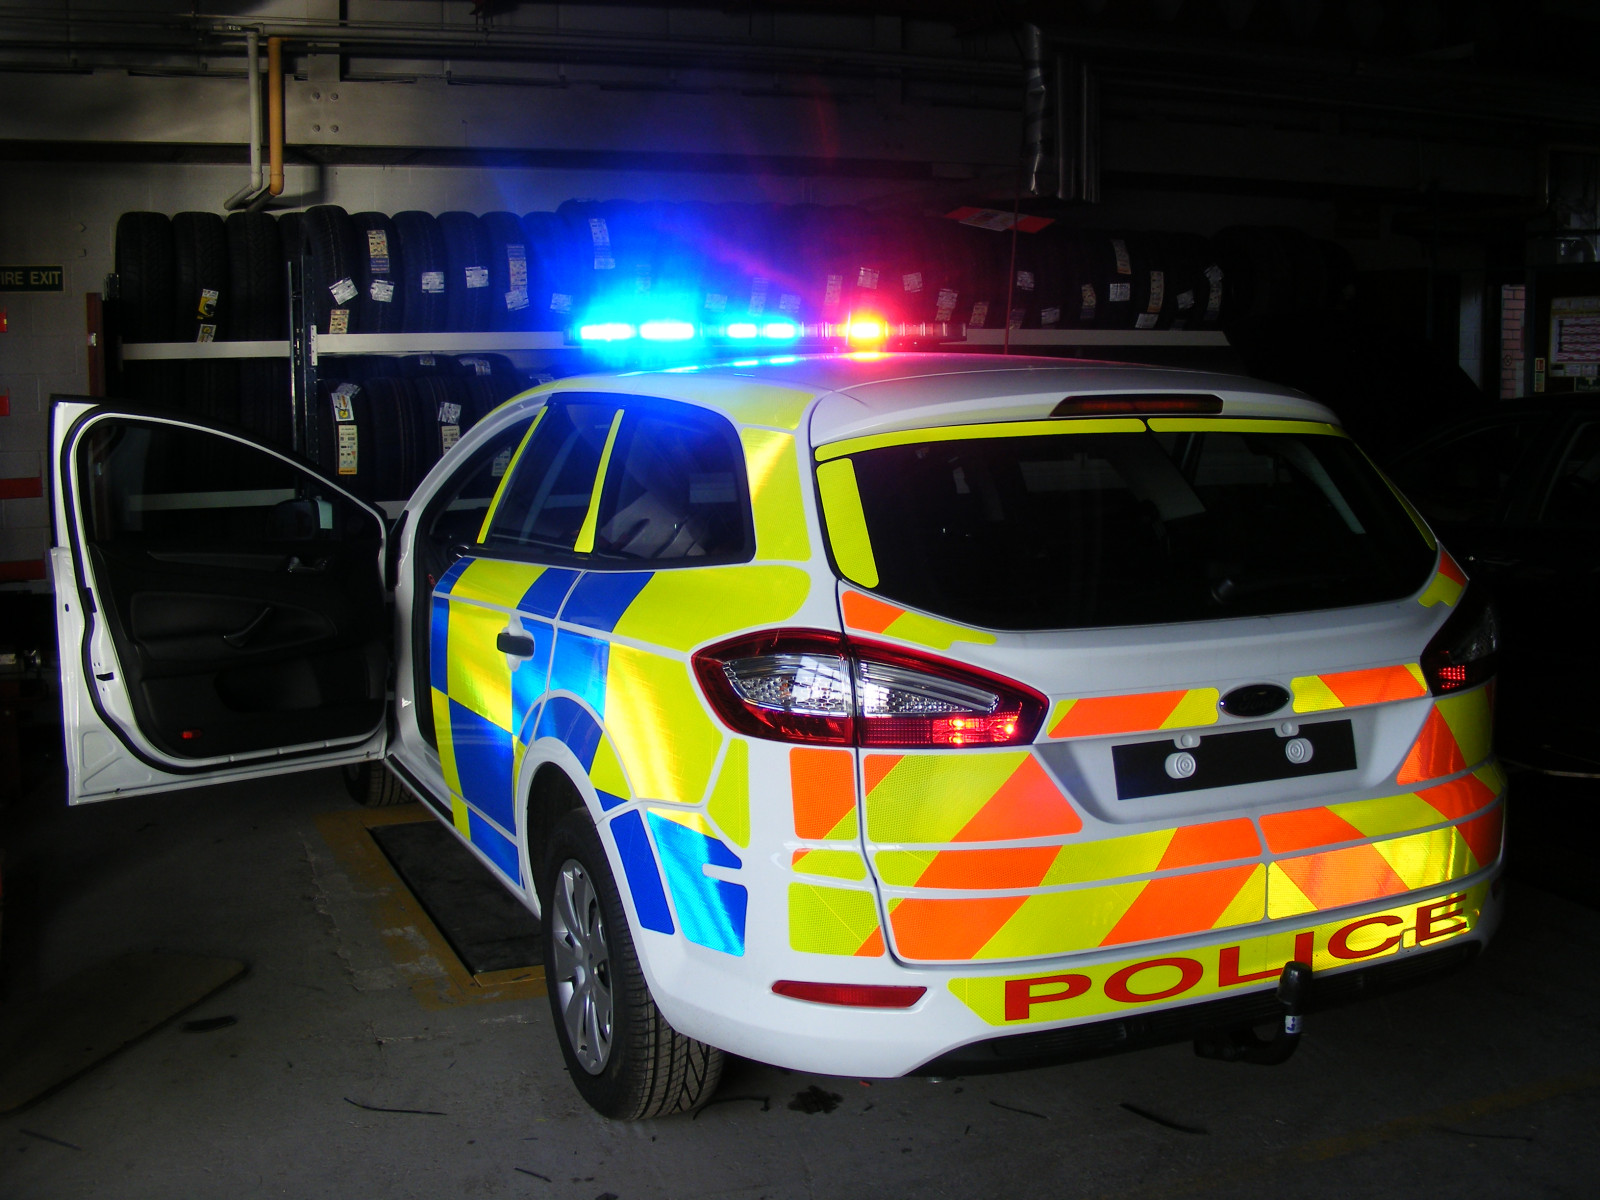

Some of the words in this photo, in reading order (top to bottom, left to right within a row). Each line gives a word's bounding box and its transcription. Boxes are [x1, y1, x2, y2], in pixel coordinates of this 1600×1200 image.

[0, 271, 24, 285] IRE
[30, 271, 61, 285] EXIT
[1004, 893, 1467, 1021] POLICE
